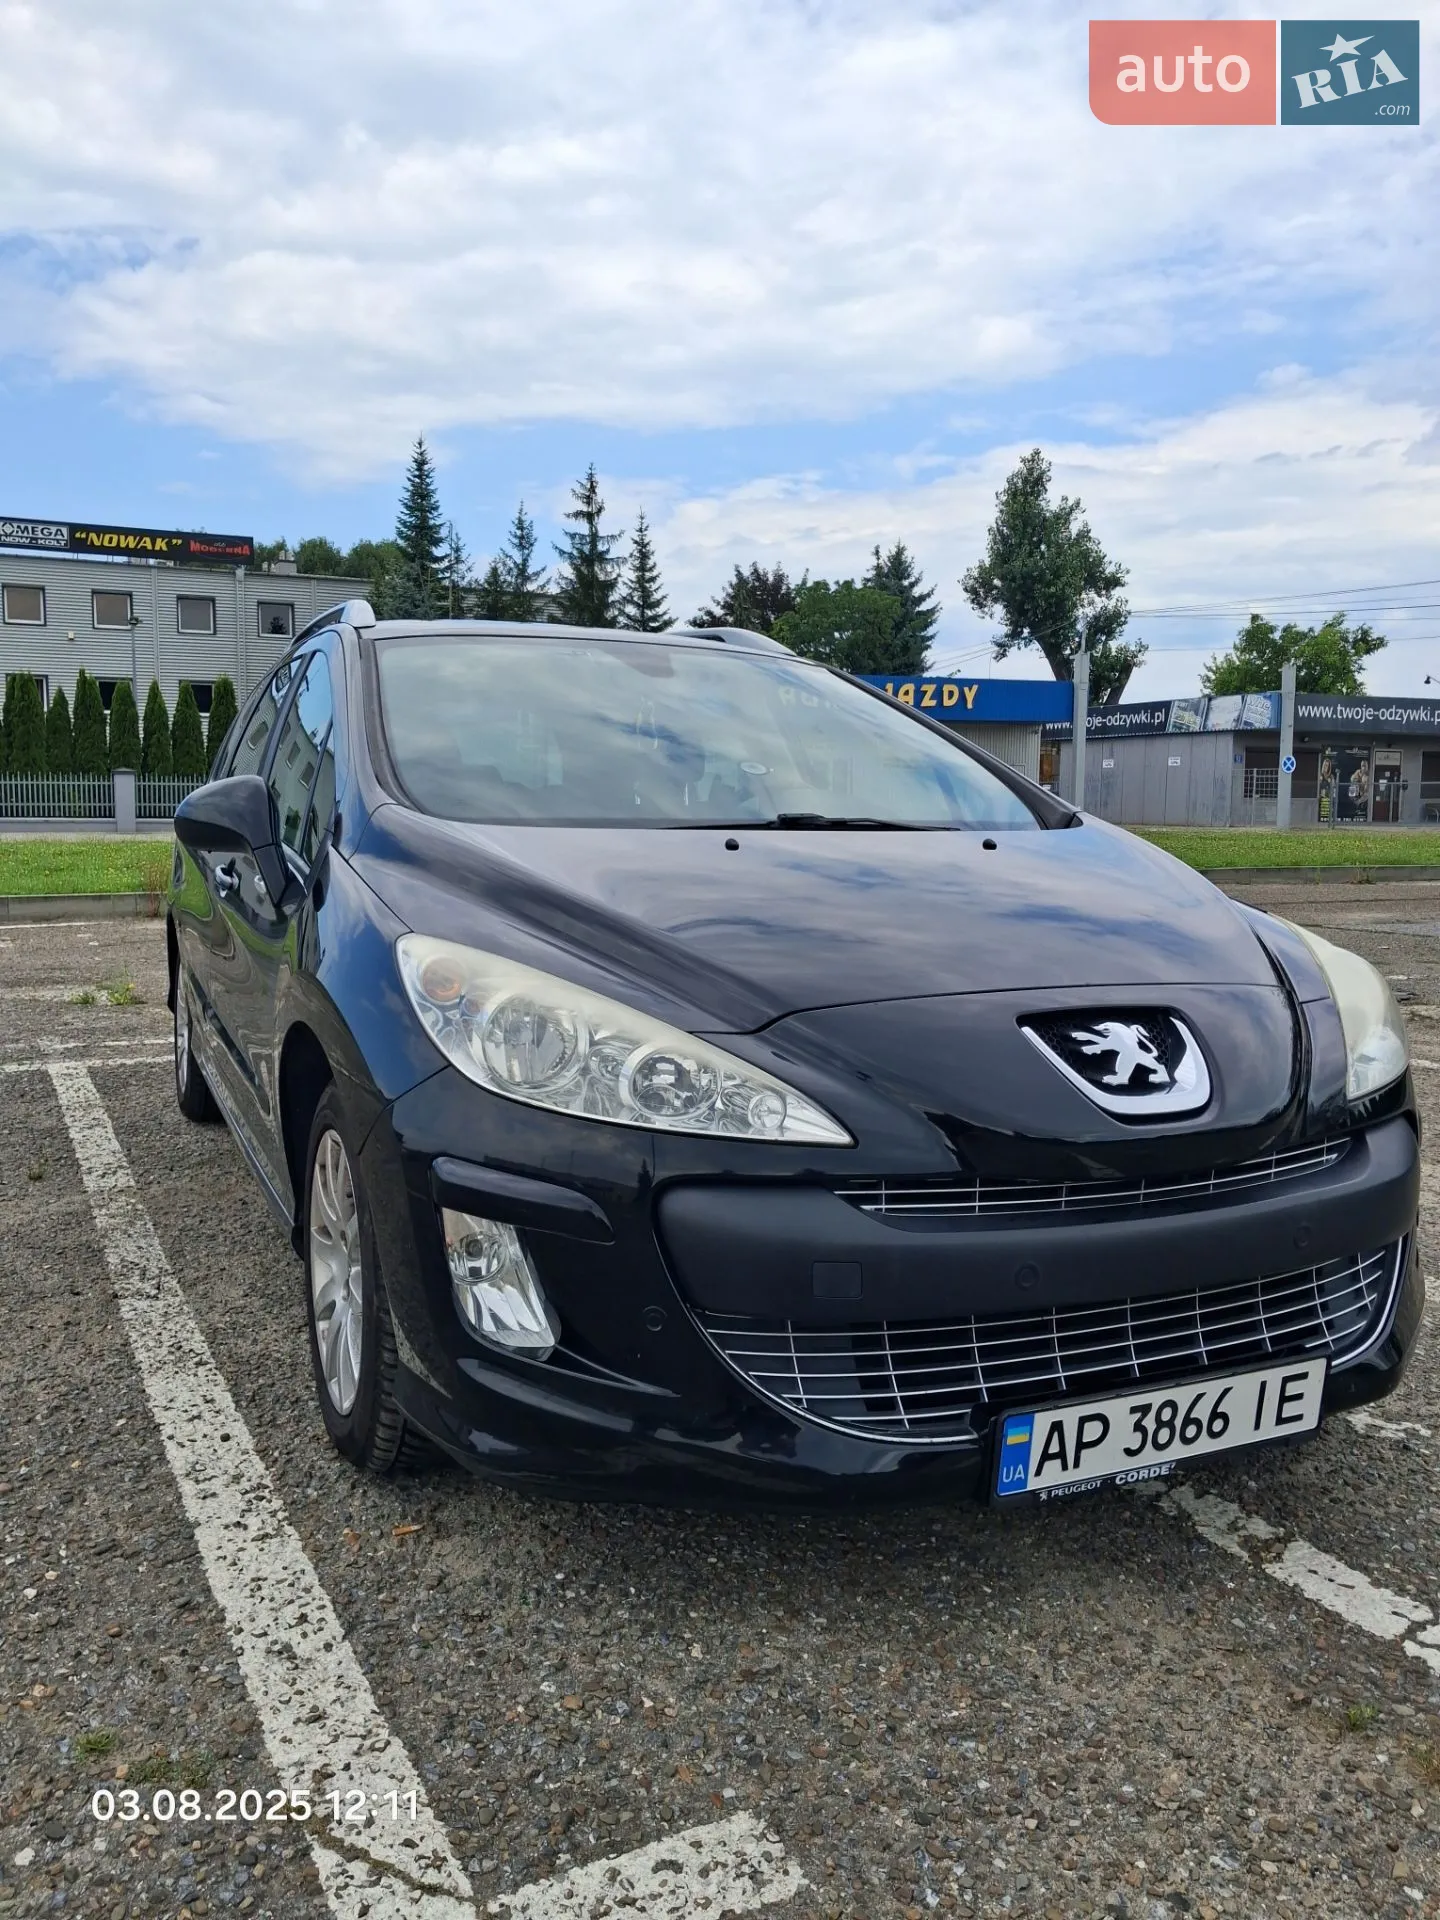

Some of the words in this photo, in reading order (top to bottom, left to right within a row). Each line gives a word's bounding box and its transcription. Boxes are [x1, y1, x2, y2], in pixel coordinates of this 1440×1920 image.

[1, 521, 65, 538] OMEGA
[1045, 708, 1166, 730] www.oje-odzywki.pl
[1033, 1412, 1110, 1478] AP
[1122, 1386, 1234, 1458] 3866
[1253, 1371, 1310, 1432] IE
[1002, 1463, 1026, 1483] UA
[1051, 1479, 1102, 1499] PEUGEOT
